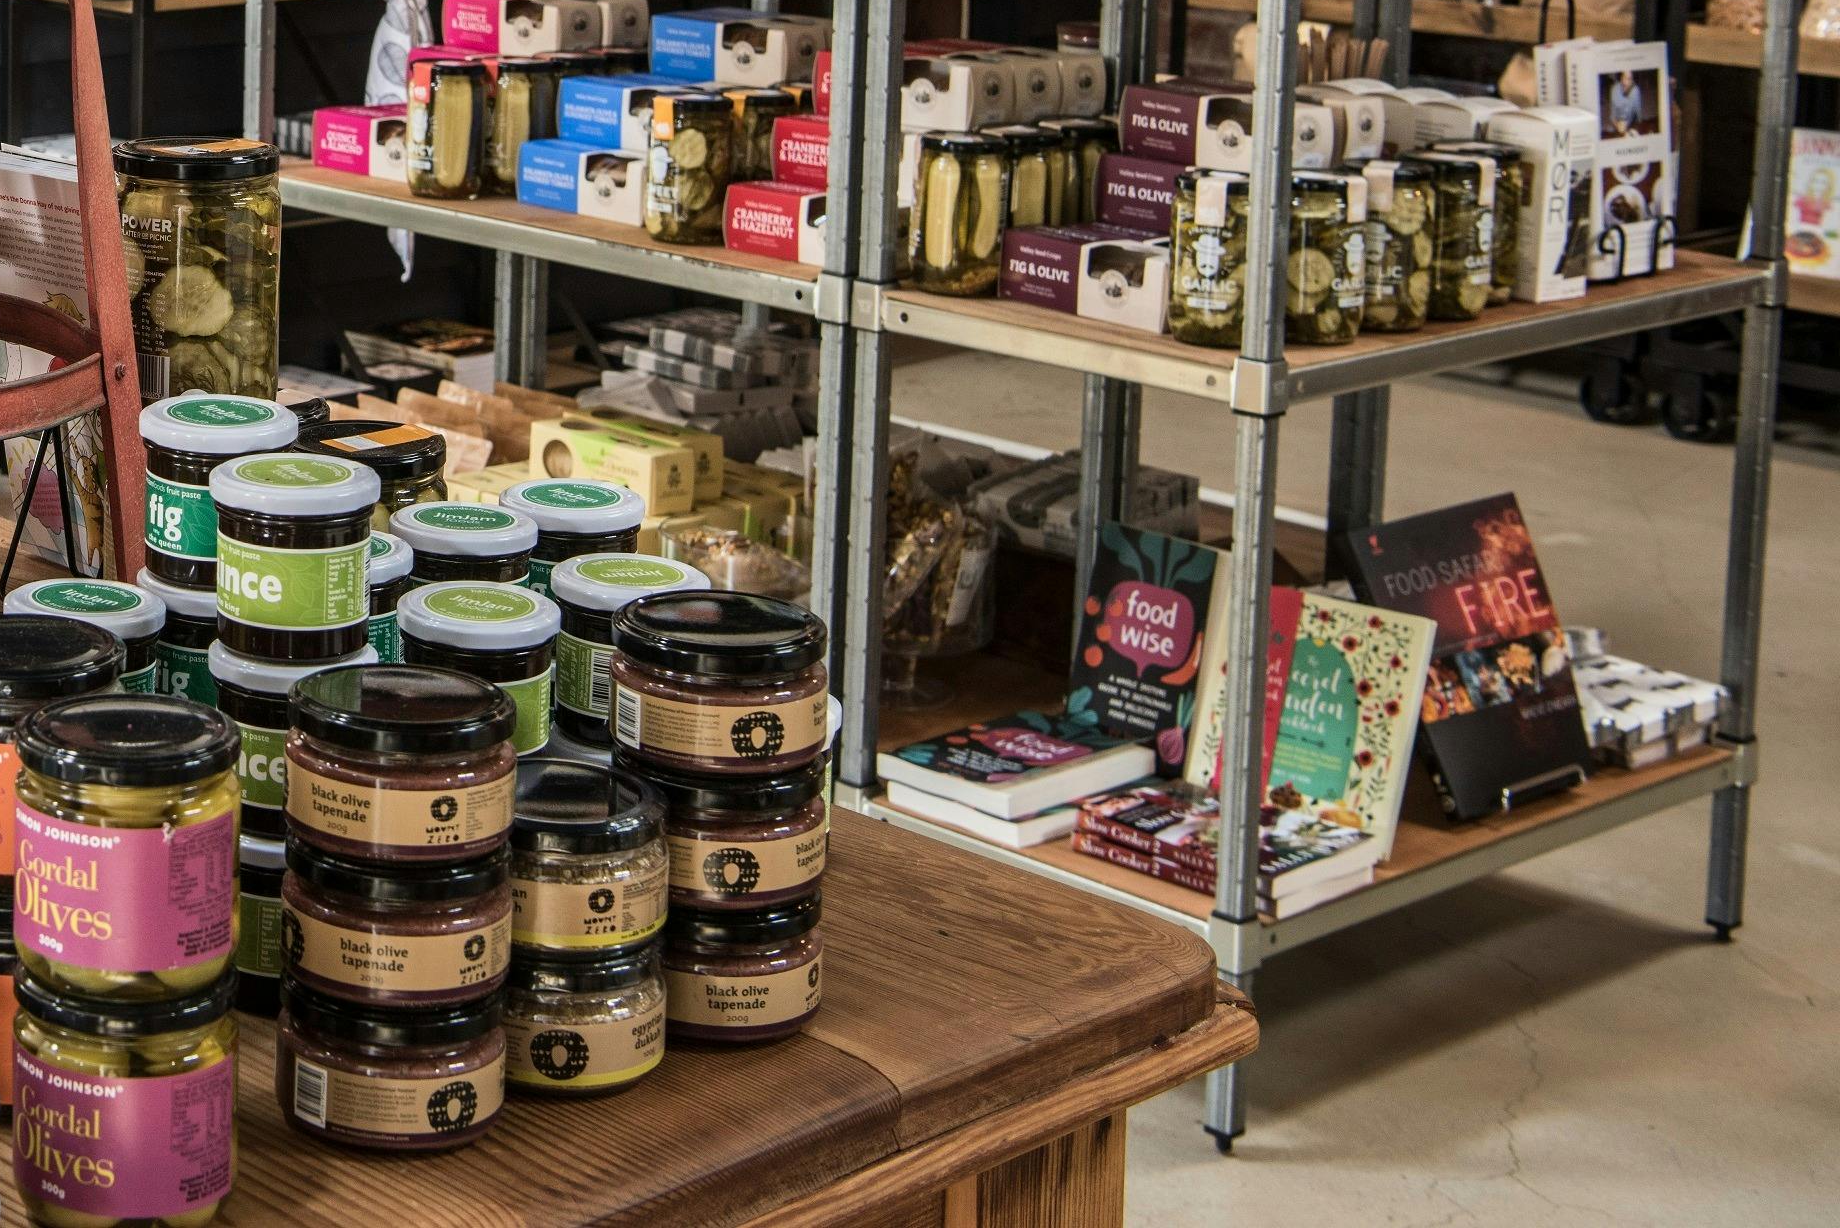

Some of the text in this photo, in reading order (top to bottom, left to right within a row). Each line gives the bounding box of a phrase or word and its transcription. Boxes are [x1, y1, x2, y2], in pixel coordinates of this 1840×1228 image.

[1131, 112, 1189, 136] FIG & OLIVE
[1107, 180, 1174, 206] FIG & OLIVE
[121, 213, 173, 233] POWER
[733, 206, 793, 227] CRANBERRY
[731, 216, 795, 240] & HAZELNUT
[1009, 258, 1070, 285] FIG & OLIVE
[1180, 275, 1237, 295] GARLIC
[199, 403, 248, 422] JimJam
[166, 487, 202, 501] fruit paste
[148, 493, 183, 542] fig
[433, 511, 497, 523] JimJam
[158, 538, 182, 552] queen
[241, 551, 260, 562] paste
[1383, 565, 1437, 599] FOOD
[58, 587, 119, 608] JimJam
[448, 593, 515, 613] JimJam
[1454, 568, 1550, 635] FIRE
[224, 601, 240, 617] king
[1127, 589, 1178, 629] food
[1120, 623, 1175, 659] wise
[172, 651, 187, 661] fruit
[249, 733, 270, 744] paste
[311, 783, 371, 809] black olive
[312, 799, 367, 823] tapenade
[327, 821, 348, 835] 200g
[1082, 813, 1108, 835] Slow
[1109, 823, 1152, 852] Cooker
[1079, 834, 1106, 855] Slow
[1107, 843, 1150, 872] Cooker
[15, 866, 113, 940] Olives
[584, 924, 616, 935] ZERO
[340, 938, 409, 958] black olive
[341, 952, 405, 972] tapenade
[705, 984, 770, 997] black olive
[707, 997, 767, 1011] tapenade
[726, 1014, 749, 1024] 200g
[16, 1052, 44, 1079] SIMON
[16, 1111, 115, 1189] Olives
[41, 1179, 66, 1200] 300g
